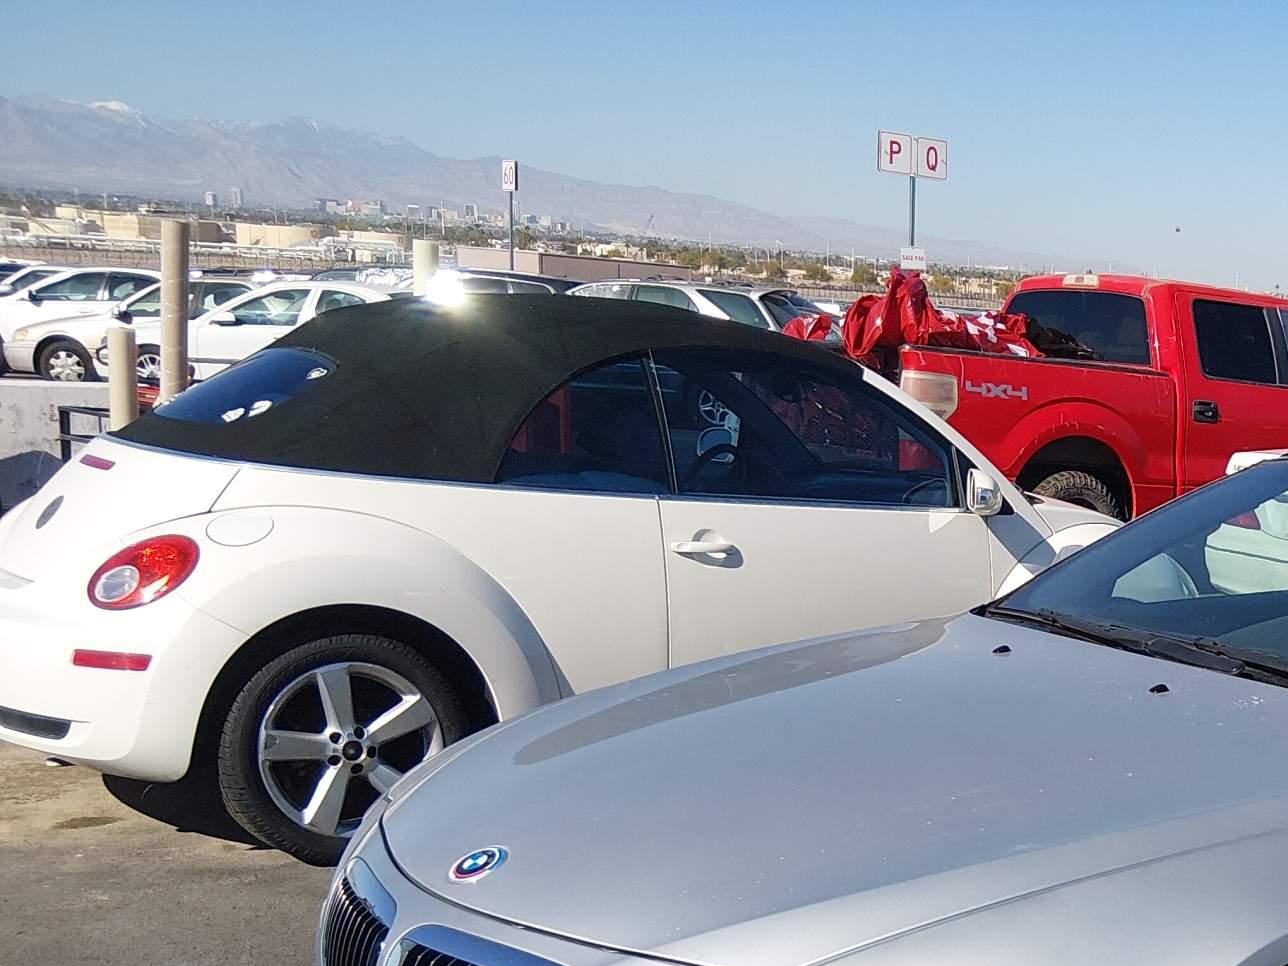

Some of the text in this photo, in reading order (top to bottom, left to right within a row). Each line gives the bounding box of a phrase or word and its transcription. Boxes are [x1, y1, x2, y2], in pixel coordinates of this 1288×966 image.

[889, 140, 902, 165] P
[926, 146, 938, 172] Q
[503, 166, 514, 185] 60
